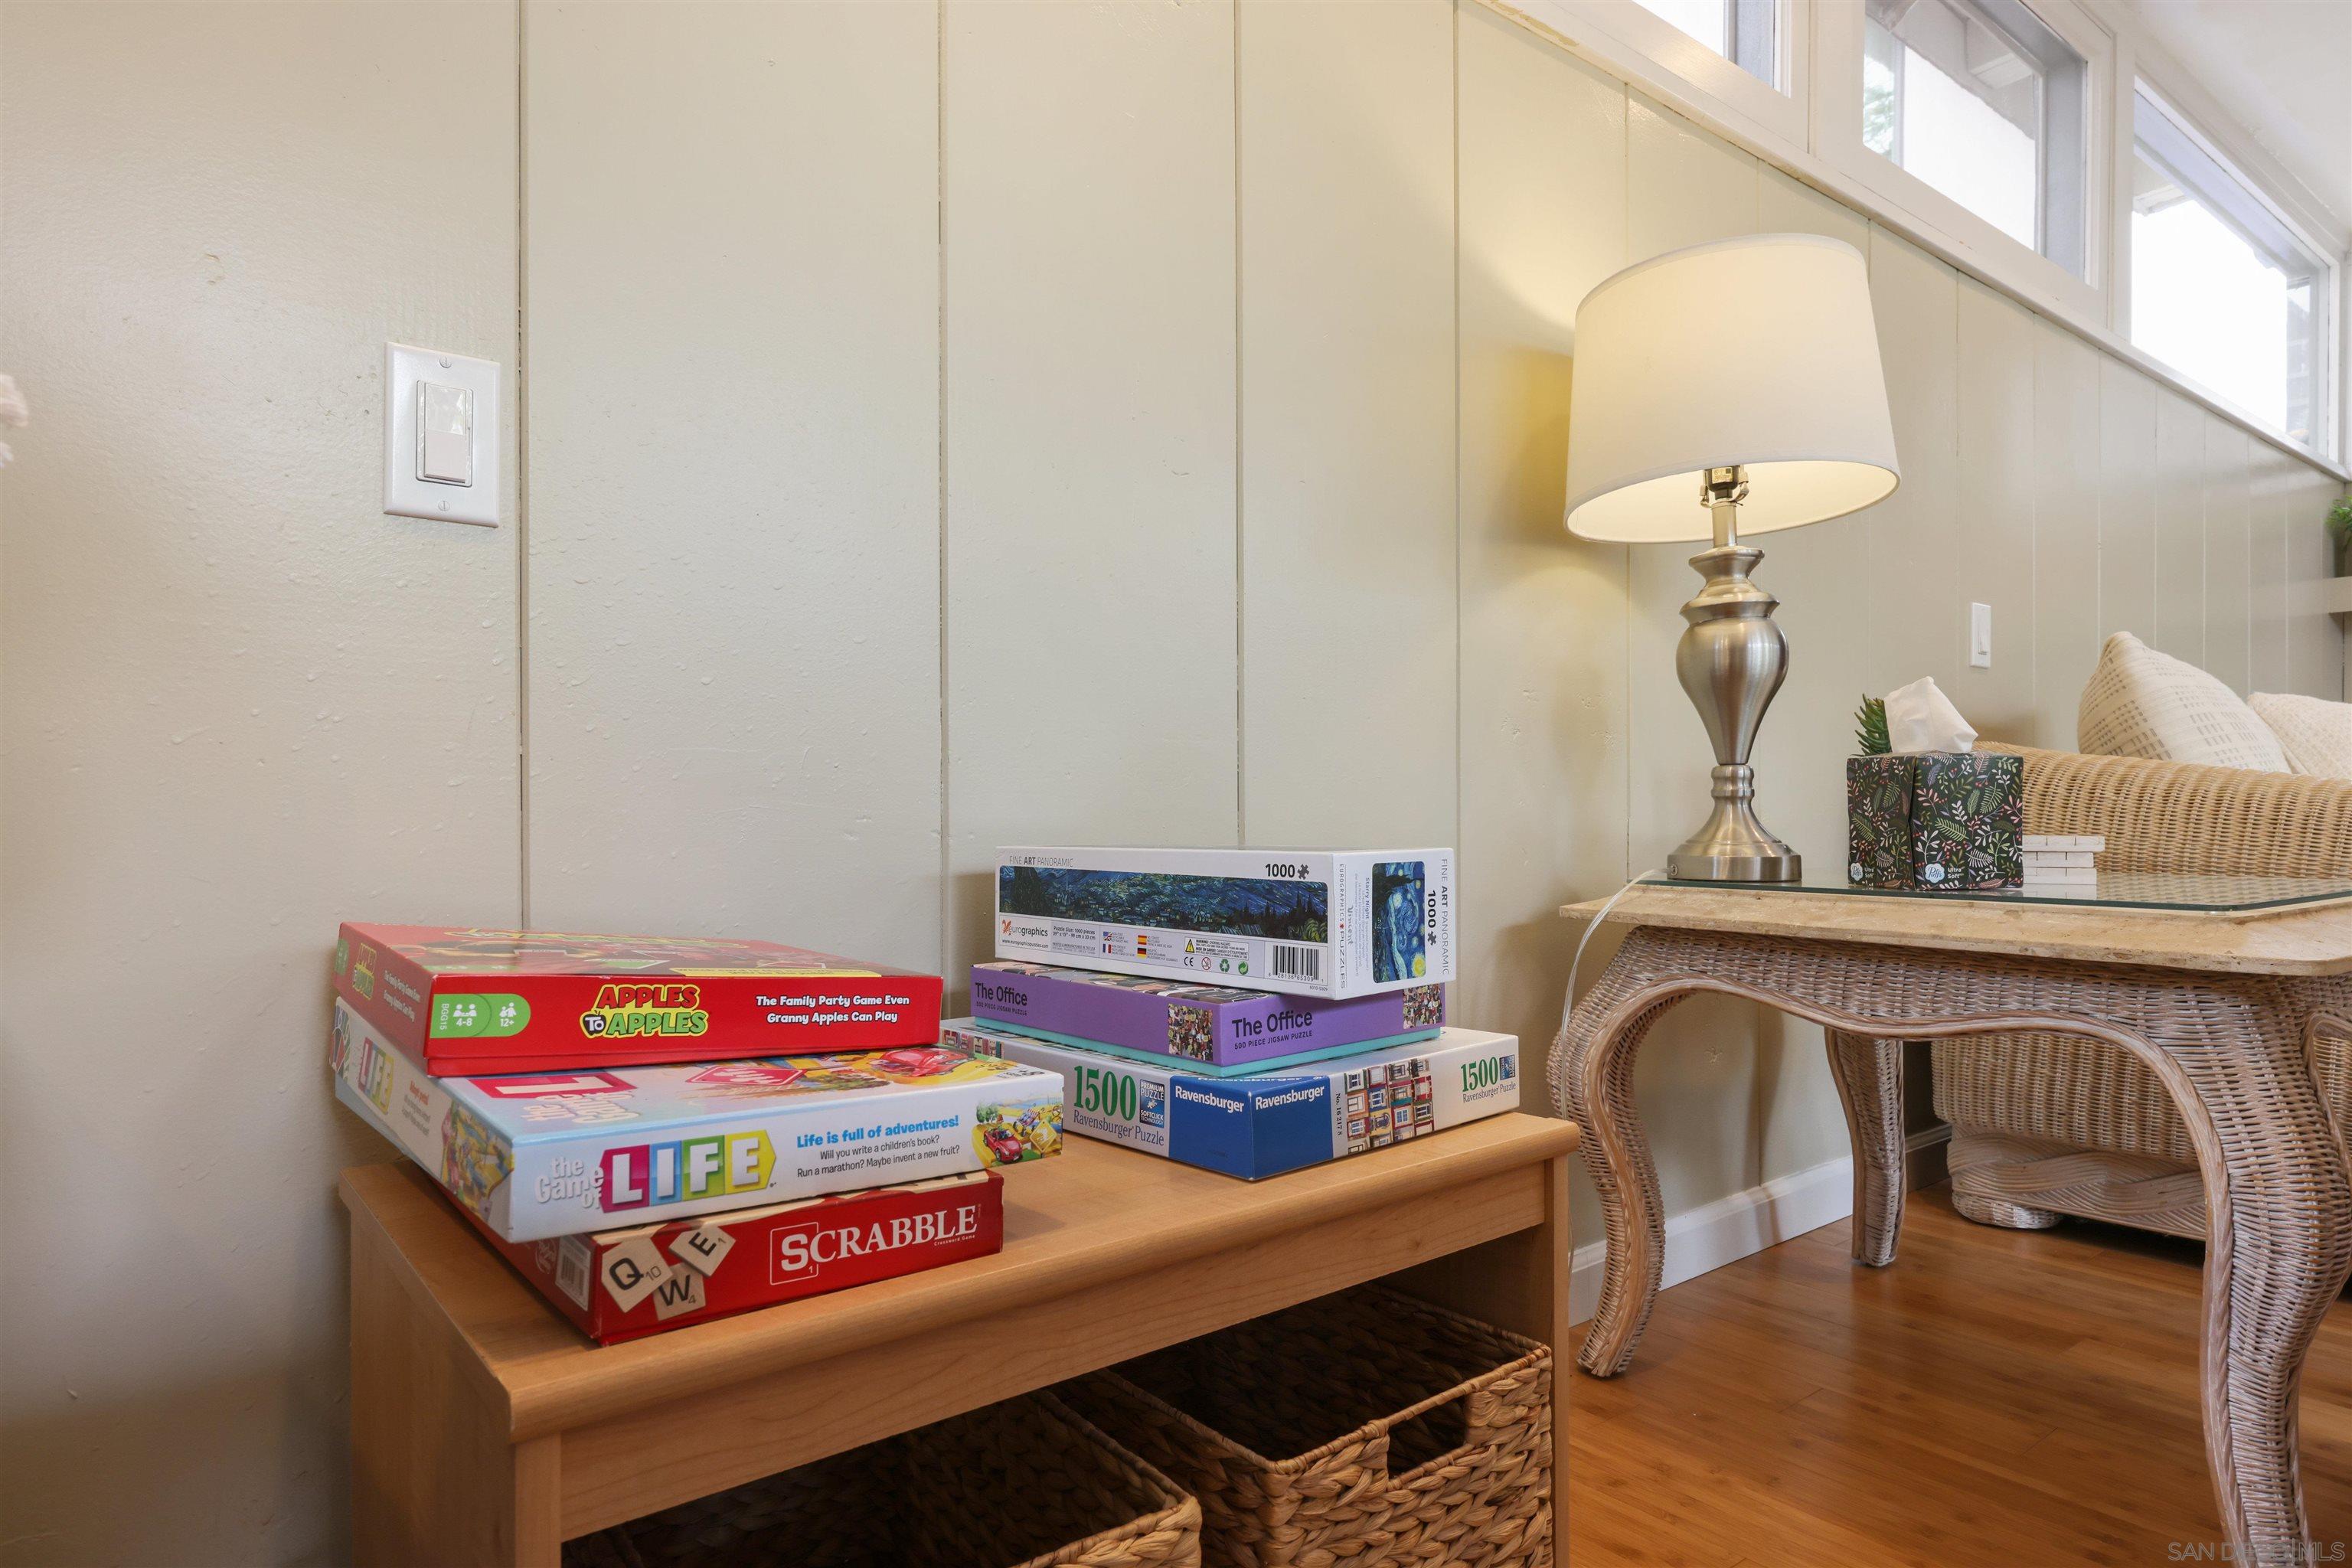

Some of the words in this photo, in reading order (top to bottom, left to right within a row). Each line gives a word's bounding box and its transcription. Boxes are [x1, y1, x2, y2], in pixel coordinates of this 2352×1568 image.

[1009, 855, 1022, 865] FINE
[1024, 856, 1036, 865] ART
[1037, 857, 1073, 867] PANORAMIC
[1265, 863, 1295, 878] 1000
[1927, 866, 1942, 877] Puffs
[1427, 890, 1436, 929] 1000
[1008, 925, 1048, 937] eurographics
[597, 985, 698, 1010] APPLES
[756, 995, 779, 1008] The
[780, 995, 817, 1009] Family
[818, 995, 851, 1008] Party
[852, 995, 883, 1006] Game
[884, 995, 910, 1006] Even
[975, 982, 994, 1000] The
[996, 985, 1027, 1006] Office
[439, 1003, 450, 1031] BGG15
[456, 1017, 473, 1027] 4-8
[500, 1017, 514, 1027] 12+
[607, 1011, 707, 1035] APPLES
[766, 1011, 809, 1027] Granny
[812, 1011, 849, 1025] Apples
[851, 1010, 874, 1022] Can
[874, 1010, 898, 1024] Play
[1231, 1017, 1263, 1038] The
[1266, 1010, 1313, 1033] Office
[1234, 1041, 1246, 1050] 500
[1248, 1038, 1266, 1047] PIECE
[1268, 1034, 1289, 1044] JIGSAW
[1291, 1030, 1313, 1040] PUZZLE
[1141, 1080, 1164, 1093] PREMIUM
[1460, 1057, 1498, 1093] 1500
[1073, 1065, 1137, 1121] 1500
[1141, 1088, 1164, 1101] PUZZLE
[1174, 1085, 1245, 1113] Ravensburger
[1255, 1084, 1325, 1110] Ravensburger
[1462, 1087, 1499, 1103] Ravensburger
[1500, 1081, 1517, 1093] Puzzle
[1140, 1109, 1164, 1121] SOFTCLICK
[797, 1134, 824, 1148] Life
[827, 1132, 839, 1145] is
[842, 1127, 864, 1142] full
[867, 1124, 882, 1138] of
[885, 1115, 959, 1136] adventures!
[1073, 1109, 1132, 1139] Ravensburger
[1135, 1125, 1165, 1147] Puzzle
[820, 1149, 835, 1161] Will
[835, 1149, 851, 1162] you
[852, 1145, 873, 1157] write
[880, 1138, 916, 1153] children's
[917, 1135, 939, 1148] book?
[550, 1156, 584, 1178] the
[612, 1137, 760, 1205] LIFE
[797, 1168, 813, 1178] Run
[822, 1159, 865, 1174] marathon?
[866, 1156, 891, 1170] Maybe
[893, 1152, 916, 1165] invent
[923, 1150, 939, 1159] new
[939, 1145, 960, 1157] fruit?
[537, 1165, 604, 1204] Game
[583, 1187, 602, 1209] of
[688, 1231, 717, 1256] E
[781, 1204, 978, 1272] SCRABBLE
[933, 1236, 961, 1246] Crossword
[609, 1257, 645, 1291] Q
[645, 1265, 662, 1282] 10
[808, 1266, 814, 1274] 1
[658, 1274, 691, 1307] W
[688, 1294, 697, 1305] 4
